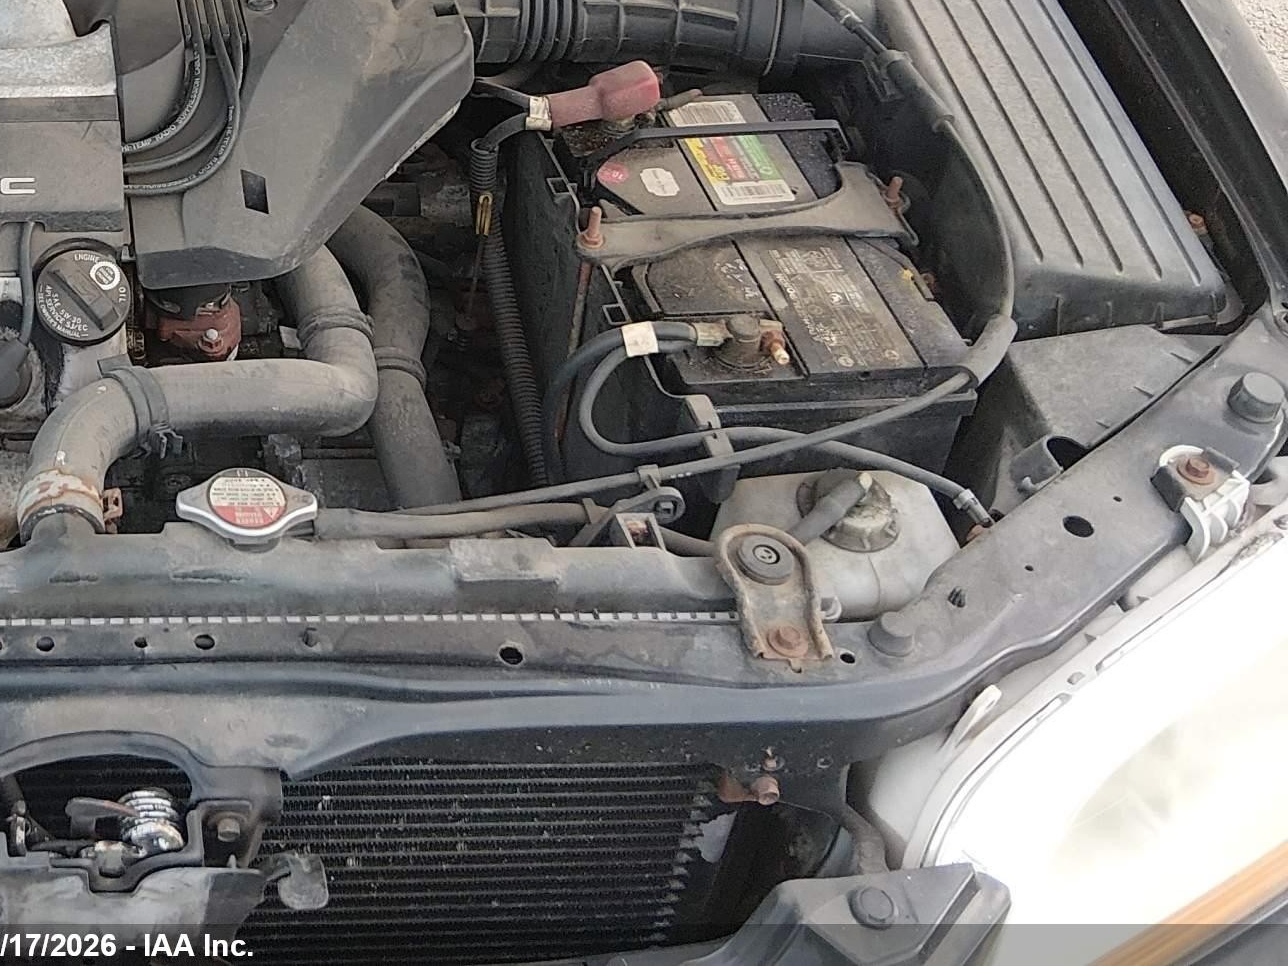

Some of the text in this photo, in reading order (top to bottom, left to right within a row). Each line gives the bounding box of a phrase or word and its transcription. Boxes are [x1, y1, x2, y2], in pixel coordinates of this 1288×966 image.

[156, 125, 176, 141] RADIO
[74, 253, 100, 263] ENGINE
[45, 284, 53, 297] API
[118, 286, 127, 303] OIL
[52, 293, 62, 307] SAE
[45, 298, 65, 324] SERVICE
